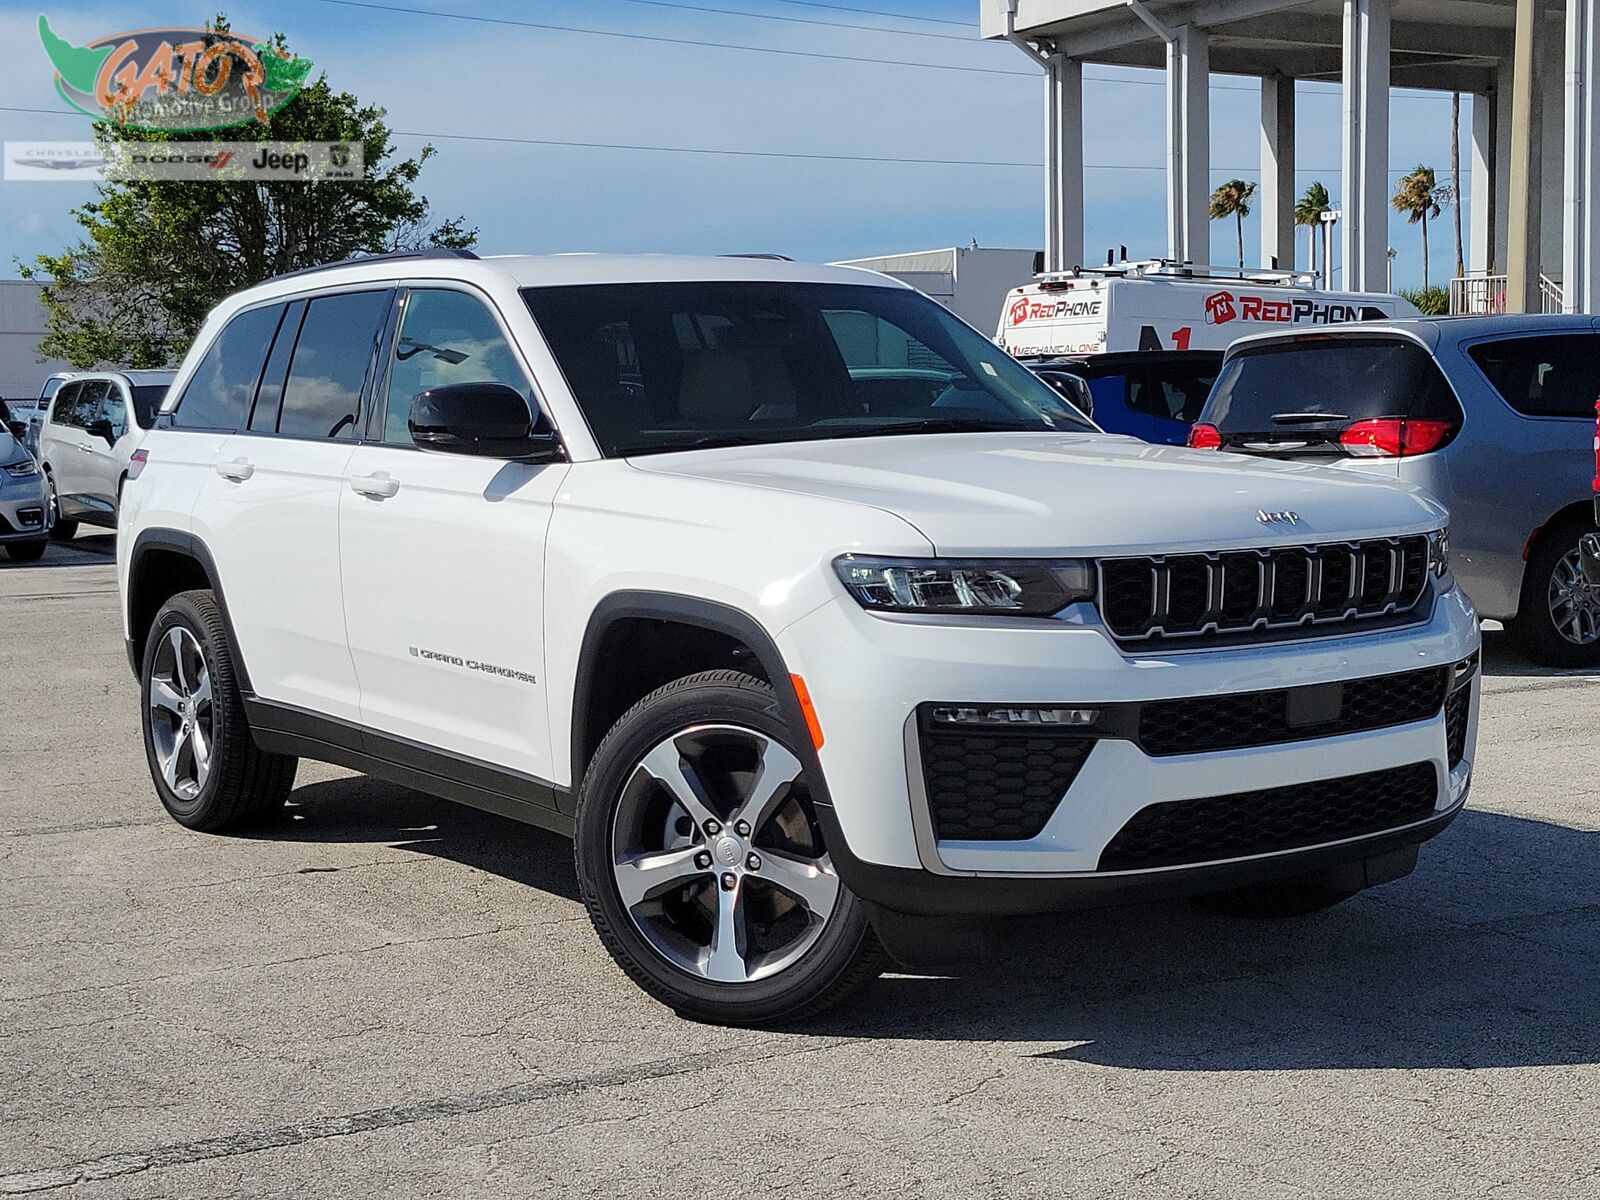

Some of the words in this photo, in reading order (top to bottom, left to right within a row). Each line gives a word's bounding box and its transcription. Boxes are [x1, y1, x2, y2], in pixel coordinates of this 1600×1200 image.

[1078, 343, 1101, 353] ONE
[1255, 509, 1299, 526] Jeep
[420, 650, 464, 667] GRAND
[466, 660, 537, 685] CHEROKEE
